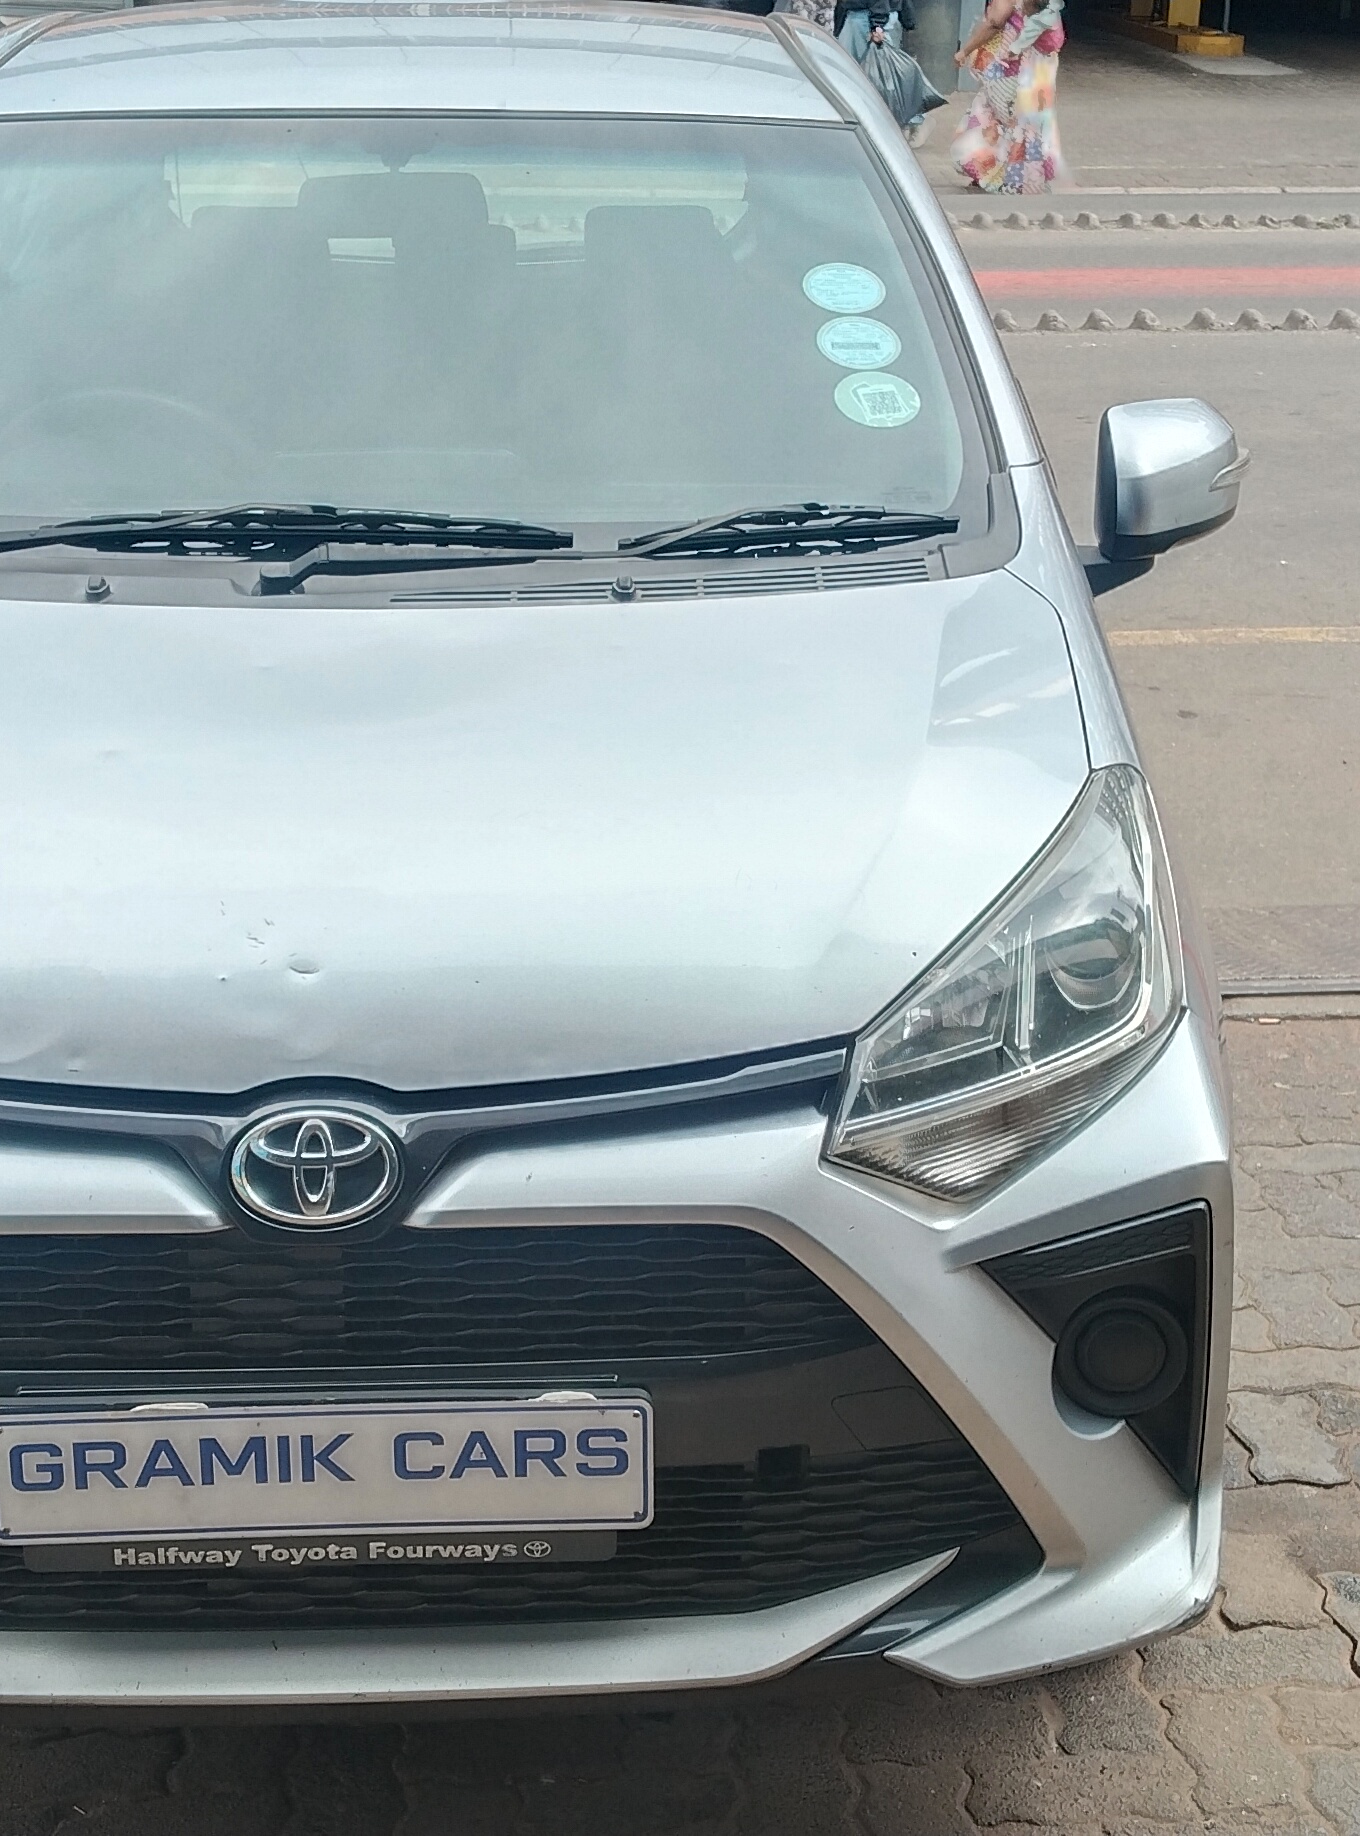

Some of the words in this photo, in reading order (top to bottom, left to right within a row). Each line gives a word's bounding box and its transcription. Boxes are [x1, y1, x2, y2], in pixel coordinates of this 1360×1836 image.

[8, 1432, 357, 1492] GRAMIK
[393, 1427, 630, 1480] CARS
[113, 1546, 242, 1568] Halfway
[251, 1543, 358, 1565] Toyota
[368, 1541, 518, 1562] Fourways
